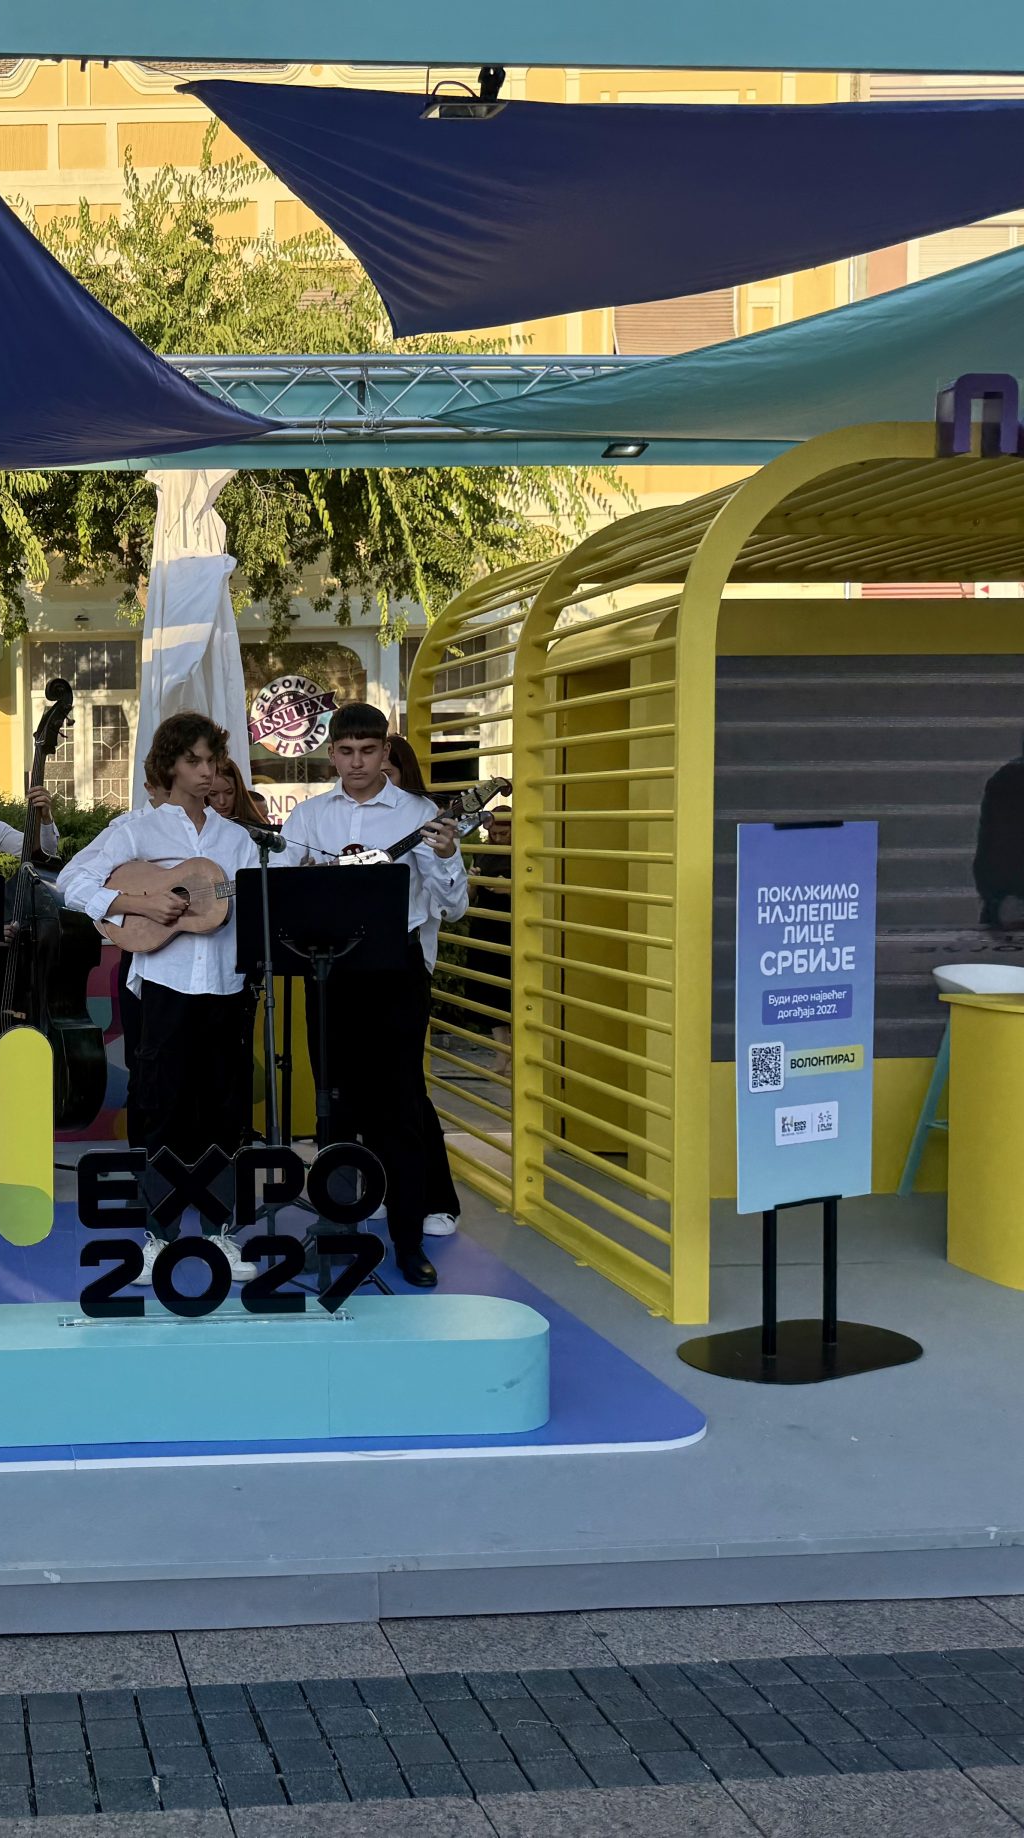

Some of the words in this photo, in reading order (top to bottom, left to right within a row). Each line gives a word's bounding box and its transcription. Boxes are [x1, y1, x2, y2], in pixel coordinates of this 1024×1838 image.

[255, 679, 317, 713] SECOND
[254, 696, 330, 738] ISSITEX
[276, 723, 327, 755] HAND
[757, 883, 859, 903] ПОКАЖИМО
[757, 902, 859, 924] НАЈЛЕПШЕ
[782, 924, 835, 945] ЛИЦЕ
[759, 946, 856, 976] СРБИЈЕ
[768, 994, 791, 1006] Буди
[792, 994, 808, 1004] део
[810, 990, 847, 1003] највећег
[777, 1005, 815, 1019] догађаја
[816, 1004, 838, 1015] 2027.
[790, 1052, 855, 1070] ВОЛОНТИРАЈ
[77, 1143, 387, 1229] EXPO
[79, 1232, 386, 1318] 2027
